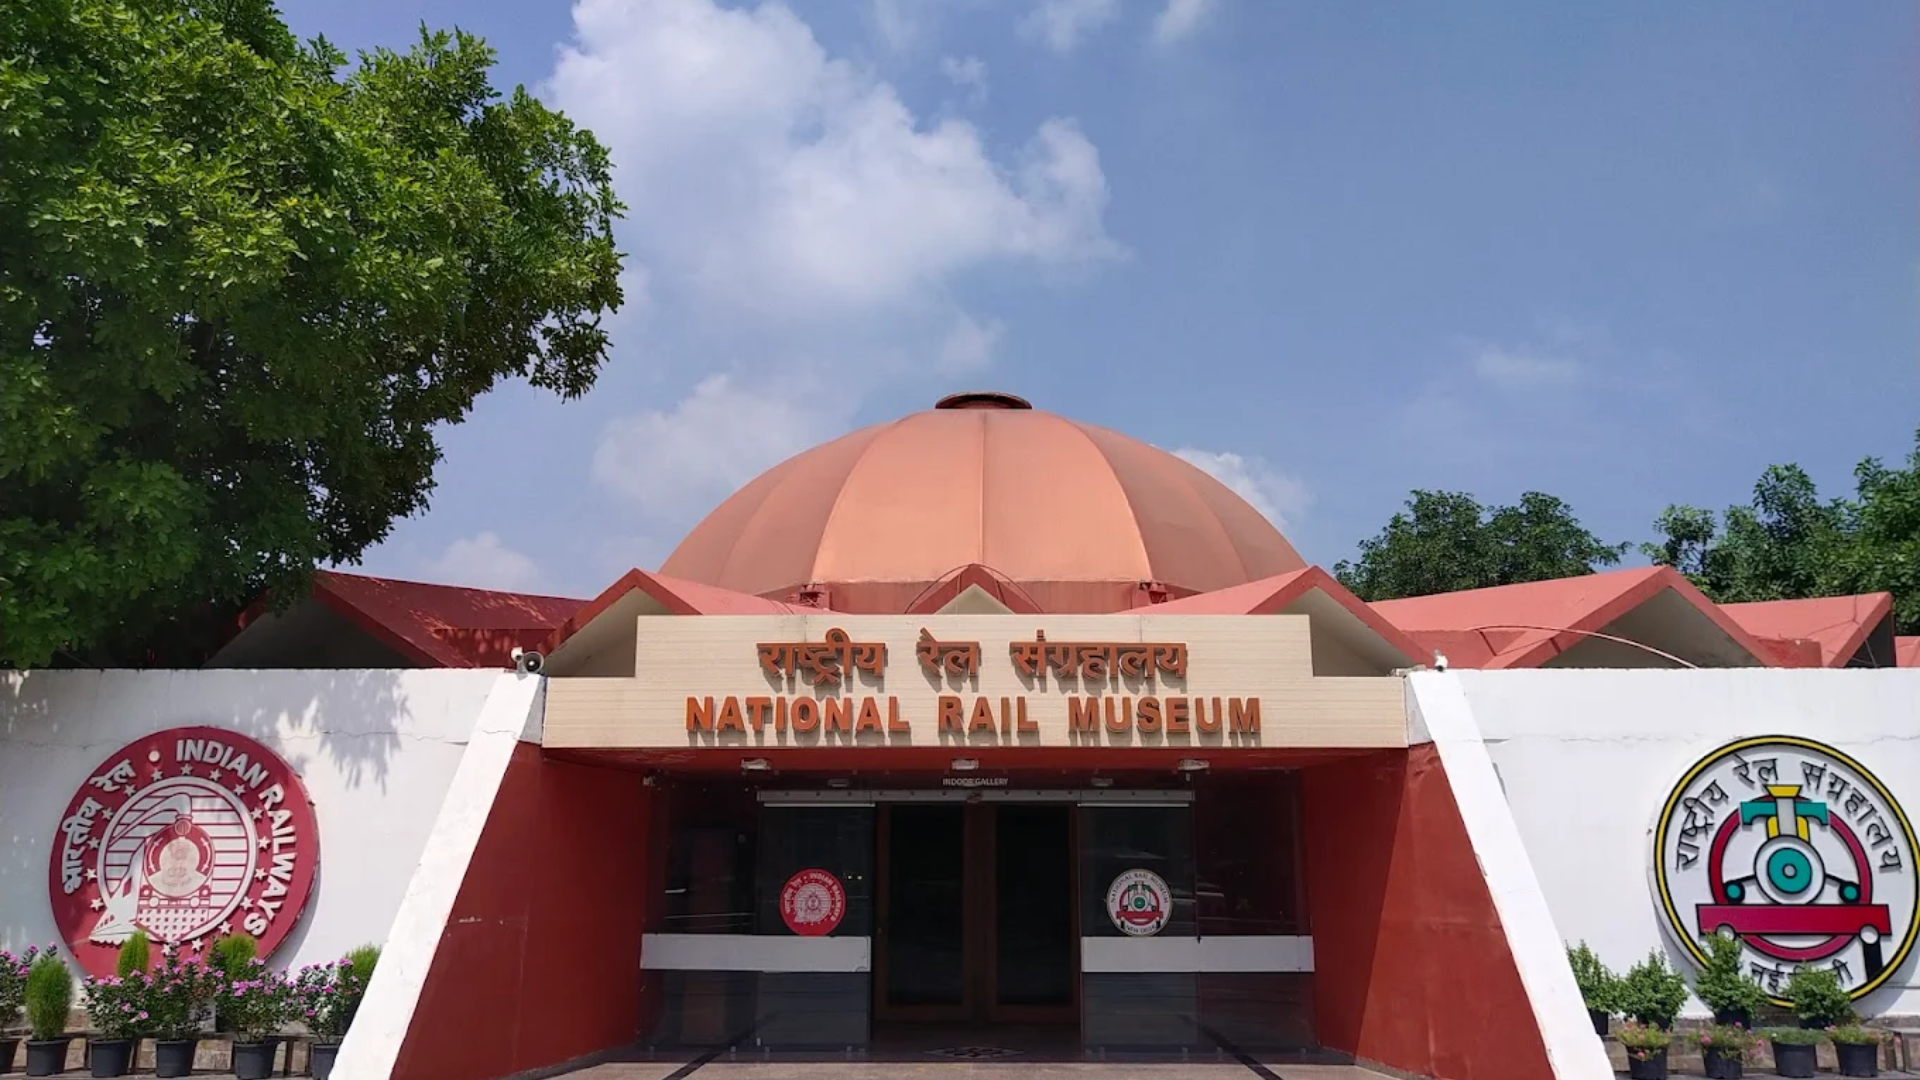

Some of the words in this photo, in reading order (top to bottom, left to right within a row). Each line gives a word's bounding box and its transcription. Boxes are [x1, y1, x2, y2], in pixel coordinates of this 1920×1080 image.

[757, 627, 886, 686] राष्ट्रीय
[916, 627, 980, 677] रेल
[1009, 629, 1187, 679] संग्रहालय
[686, 696, 910, 732] NATIONAL
[938, 696, 1039, 732] RAIL
[1068, 696, 1261, 733] MUSEUM
[61, 796, 104, 894] भारतीय
[88, 758, 136, 792] रेल
[975, 777, 1009, 787] GALLERY
[1675, 778, 1730, 874] राष्ट्रीय
[1732, 752, 1779, 785] रेल
[1800, 760, 1903, 873] संग्रहालय
[176, 739, 270, 789] INDIAN
[243, 782, 298, 936] RAILWAYS
